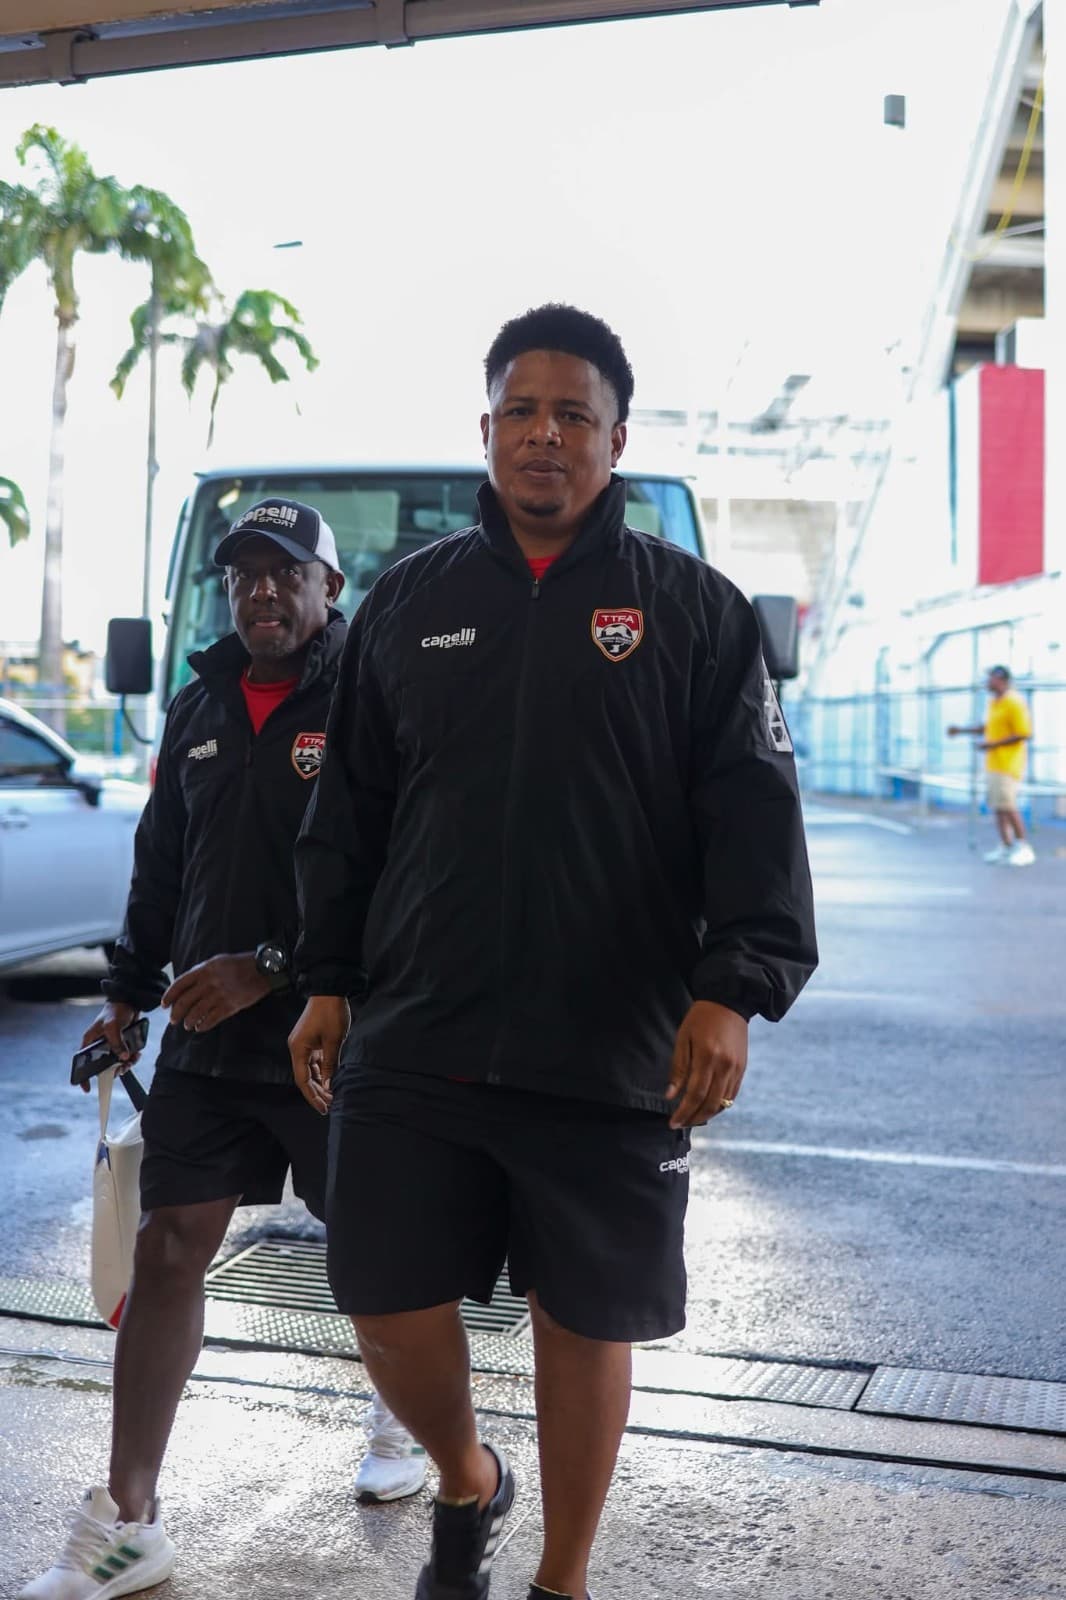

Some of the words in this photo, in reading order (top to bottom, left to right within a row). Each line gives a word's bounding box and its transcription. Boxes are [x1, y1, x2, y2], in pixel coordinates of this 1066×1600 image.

[258, 516, 296, 529] SPORT
[601, 615, 634, 624] TTFA
[421, 627, 476, 648] capelli
